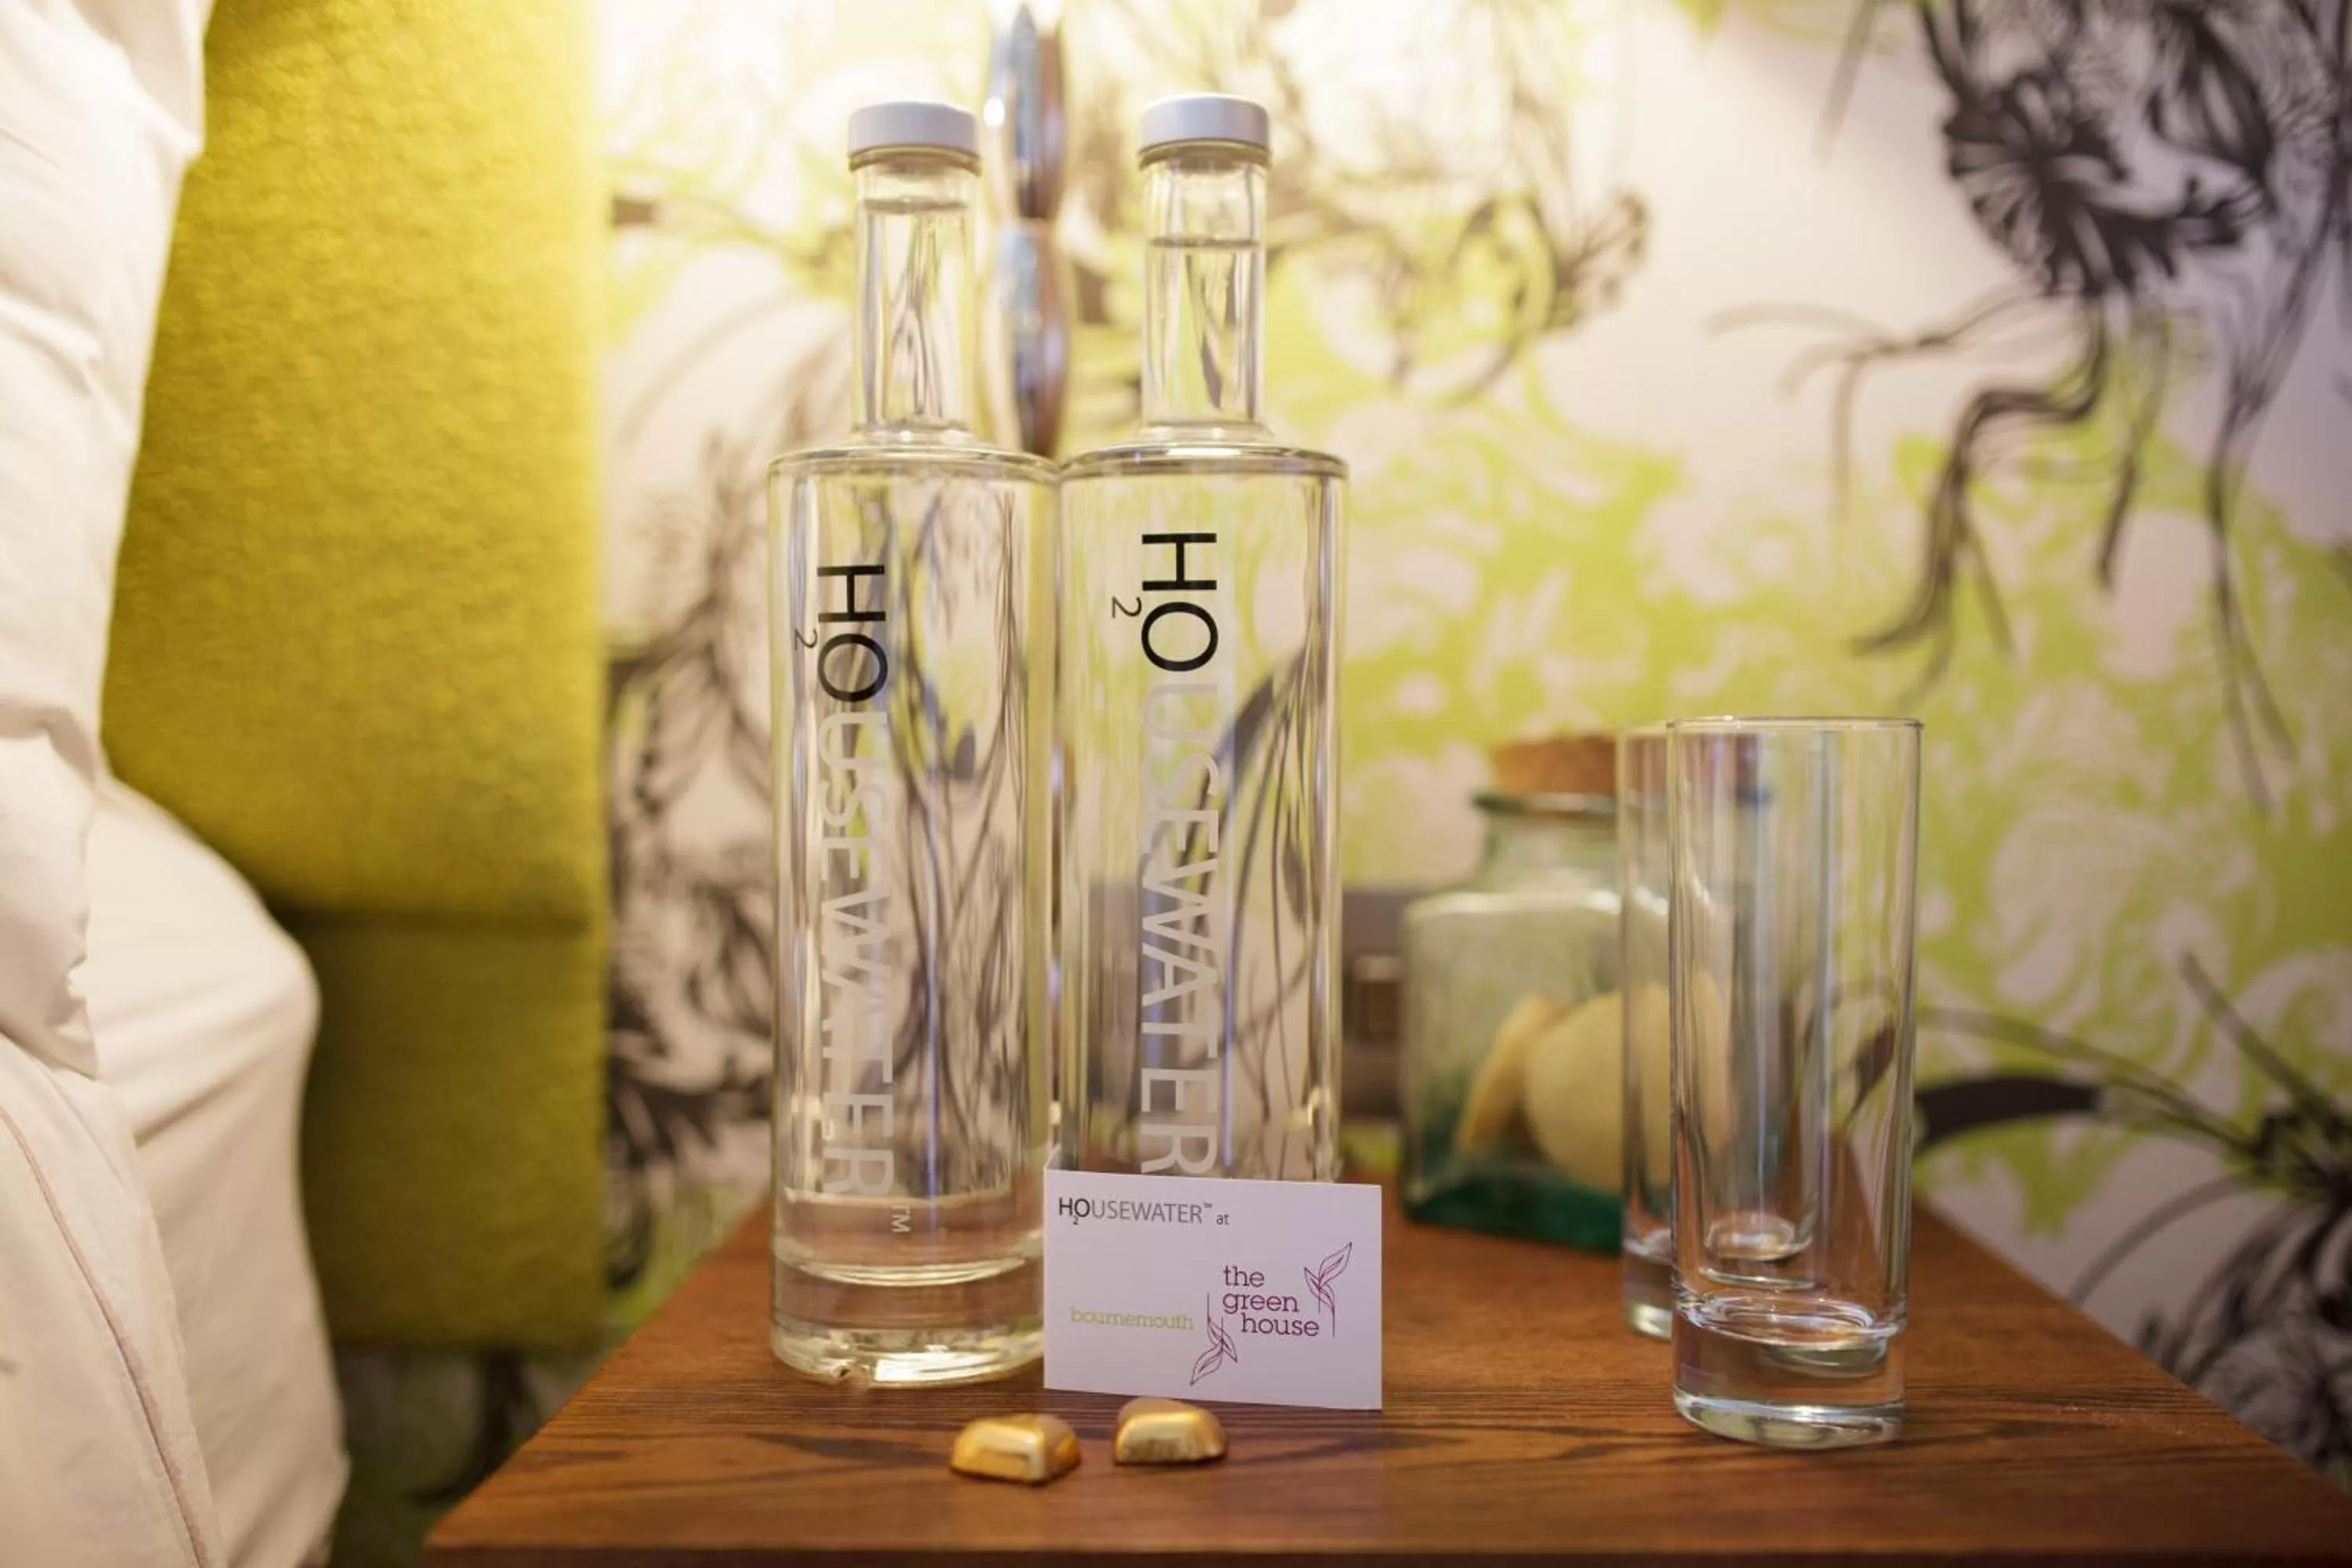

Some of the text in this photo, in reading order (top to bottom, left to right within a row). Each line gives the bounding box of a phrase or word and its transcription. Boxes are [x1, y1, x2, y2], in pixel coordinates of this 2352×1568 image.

[1216, 1214, 1230, 1225] at
[1222, 1265, 1265, 1288] the
[1221, 1292, 1300, 1315] green
[1069, 1306, 1194, 1330] bournemouth
[1240, 1312, 1319, 1337] house
